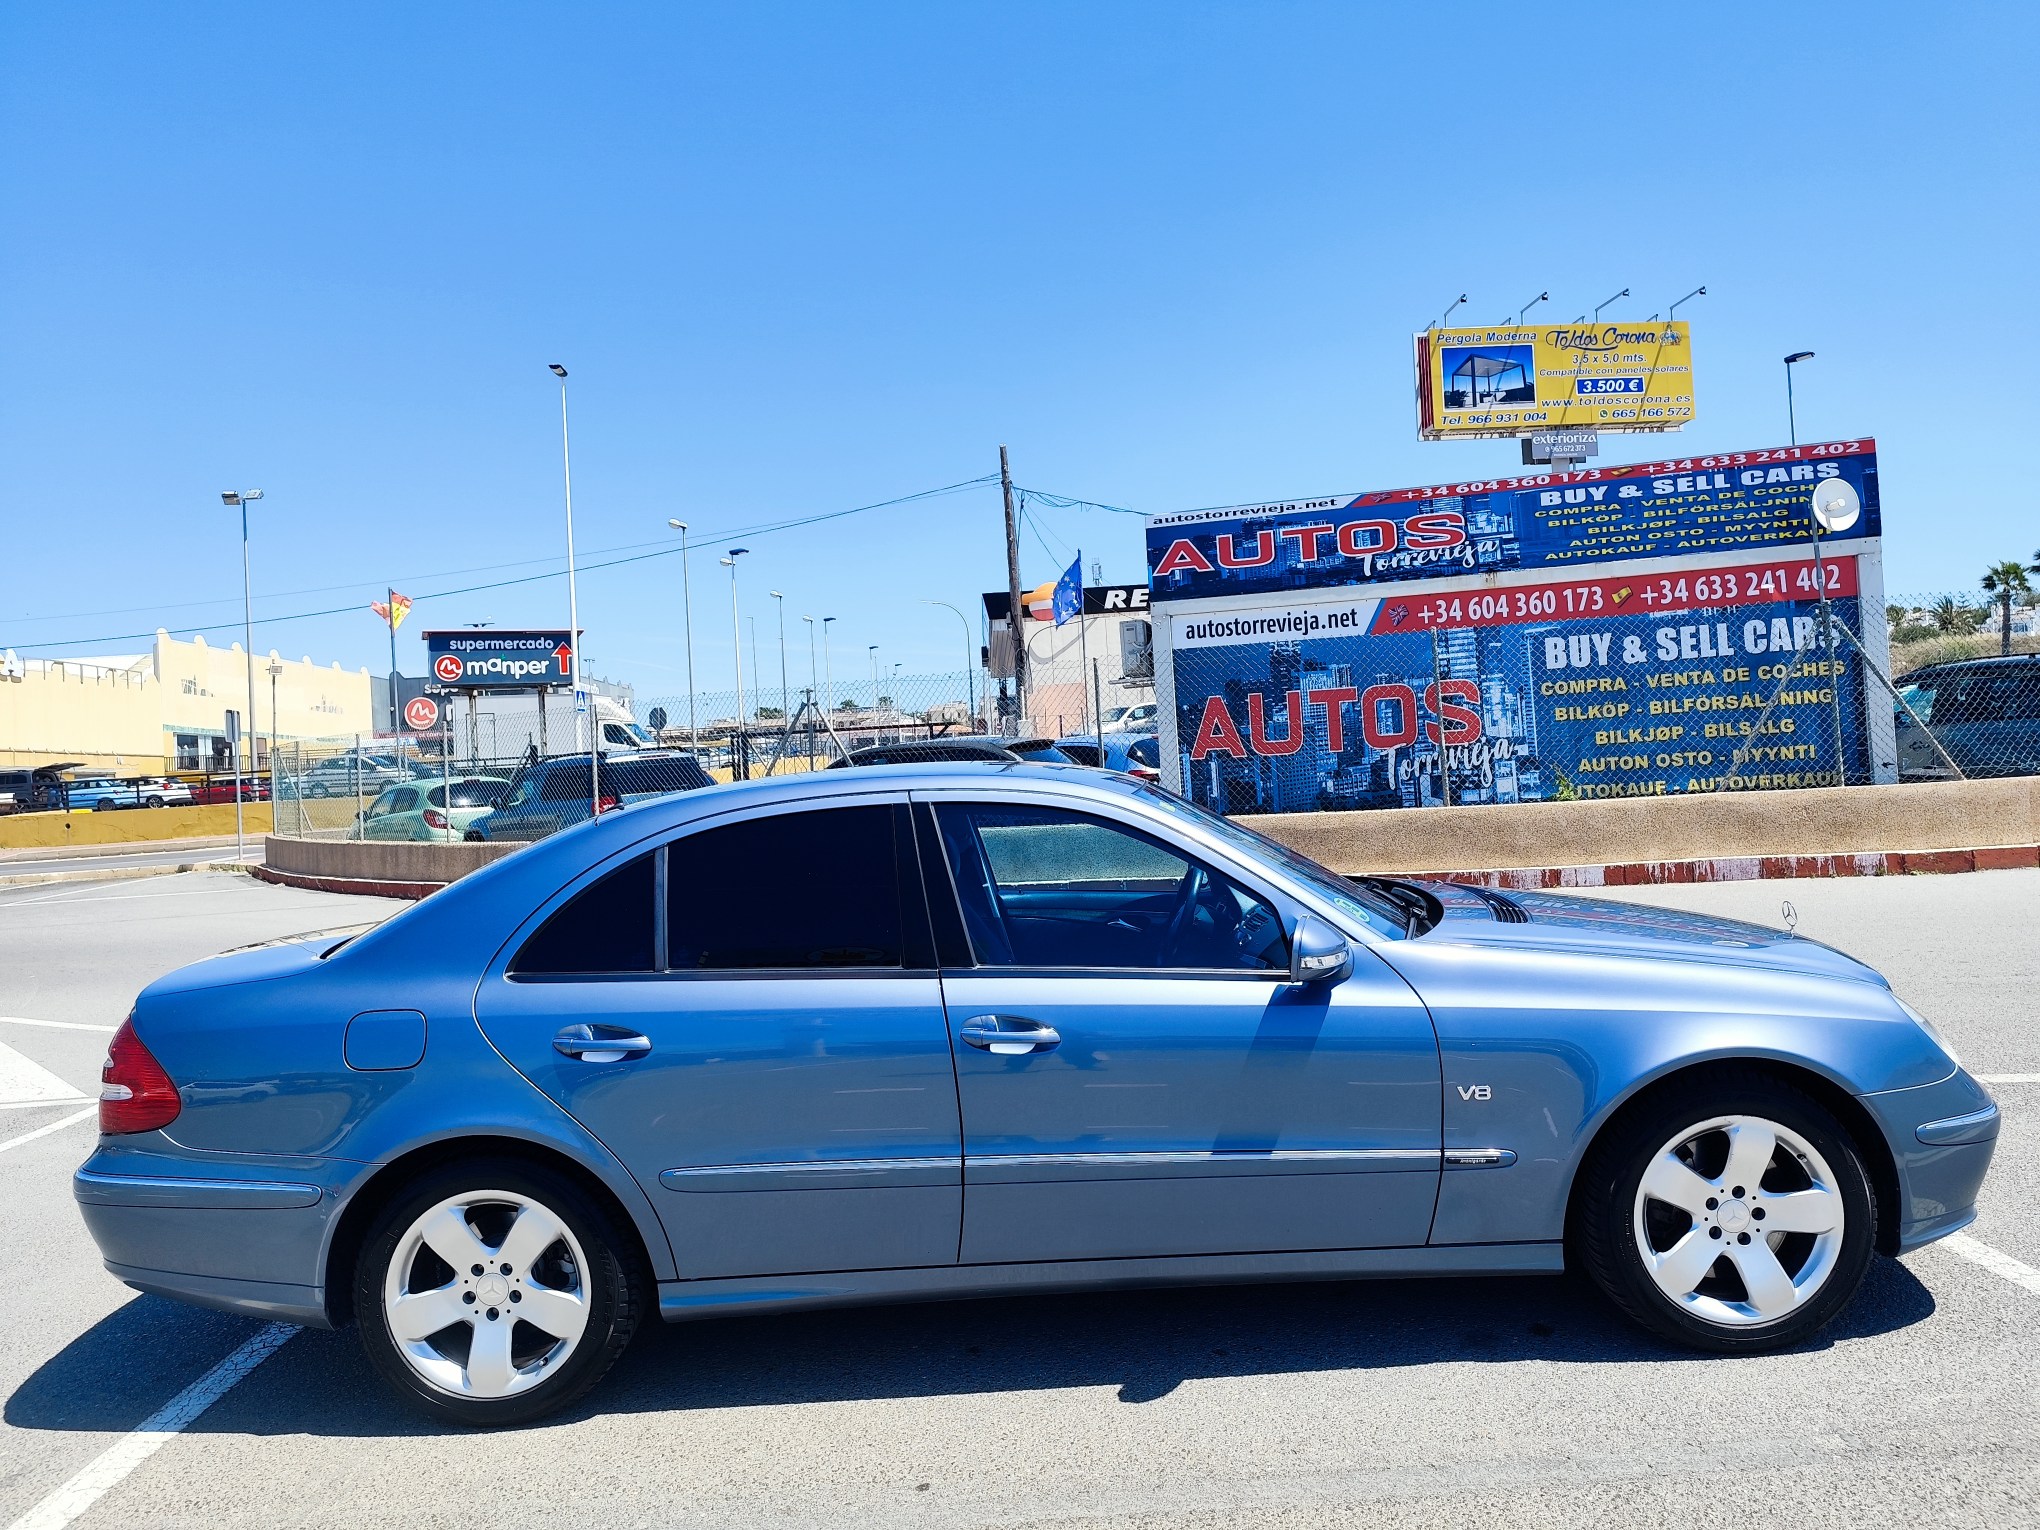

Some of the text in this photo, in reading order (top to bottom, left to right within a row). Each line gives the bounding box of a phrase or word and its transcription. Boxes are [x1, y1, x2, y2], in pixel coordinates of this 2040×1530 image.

[1436, 332, 1537, 345] Pérgola Moderna
[1546, 327, 1657, 351] Toldos Corona
[1539, 365, 1689, 377] Compatible con paneles solares
[1572, 354, 1589, 365] 3,5
[1603, 353, 1619, 364] 5,0
[1622, 353, 1647, 363] mts.
[1582, 379, 1640, 393] 3.500 €
[1541, 395, 1691, 407] www.toldoscorona.es
[1612, 407, 1691, 418] 665 166 572
[1441, 412, 1547, 425] Tel. 966 931 004
[1532, 432, 1597, 445] exterioriza
[1401, 442, 1861, 500] +34 604 360 173 +34 633 241 402
[1540, 461, 1840, 507] BUY & SELL CARS
[1153, 498, 1338, 526] autostorrevieja.net
[1534, 502, 1621, 518] COMPRA
[1640, 493, 1711, 508] VENTA
[1718, 490, 1748, 500] DE
[1753, 483, 1818, 497] COCH
[1547, 513, 1623, 529] BILKÖP
[1643, 495, 1811, 518] BILFÖRSÄLJNIN
[1569, 533, 1640, 548] AUTON
[1649, 527, 1704, 540] OSTO
[1725, 518, 1809, 533] MYYNTI
[1587, 518, 1678, 536] BILKJØP
[1697, 509, 1789, 526] BILSALG
[1151, 512, 1468, 577] AUTOS
[1355, 538, 1500, 577] Torrevieja
[1544, 543, 1657, 561] AUTOKAUF
[1417, 563, 1841, 625] +34 604 360 173 +34 633 241 402
[1185, 607, 1359, 640] autostorrevieja.net
[449, 636, 554, 653] supermercado
[1544, 631, 1613, 670] BUY
[1622, 632, 1648, 664] &
[1656, 621, 1740, 661] SELL
[466, 657, 550, 679] manper
[1541, 675, 1628, 697] COMPRA
[1647, 669, 1715, 690] VENTA
[1722, 667, 1750, 683] DE
[1555, 701, 1630, 721] BILKÖP
[1649, 688, 1833, 716] BILFÖRSÄLNING
[1190, 678, 1482, 761] AUTOS
[1595, 725, 1684, 746] BILKJØP
[1380, 736, 1515, 791] Torrvieja
[1578, 754, 1649, 772] AUTON
[1655, 750, 1713, 767] OSTO
[1732, 744, 1817, 763] MYYNTI
[1572, 781, 1667, 799] UTOKAUF
[1456, 1084, 1492, 1101] V8
